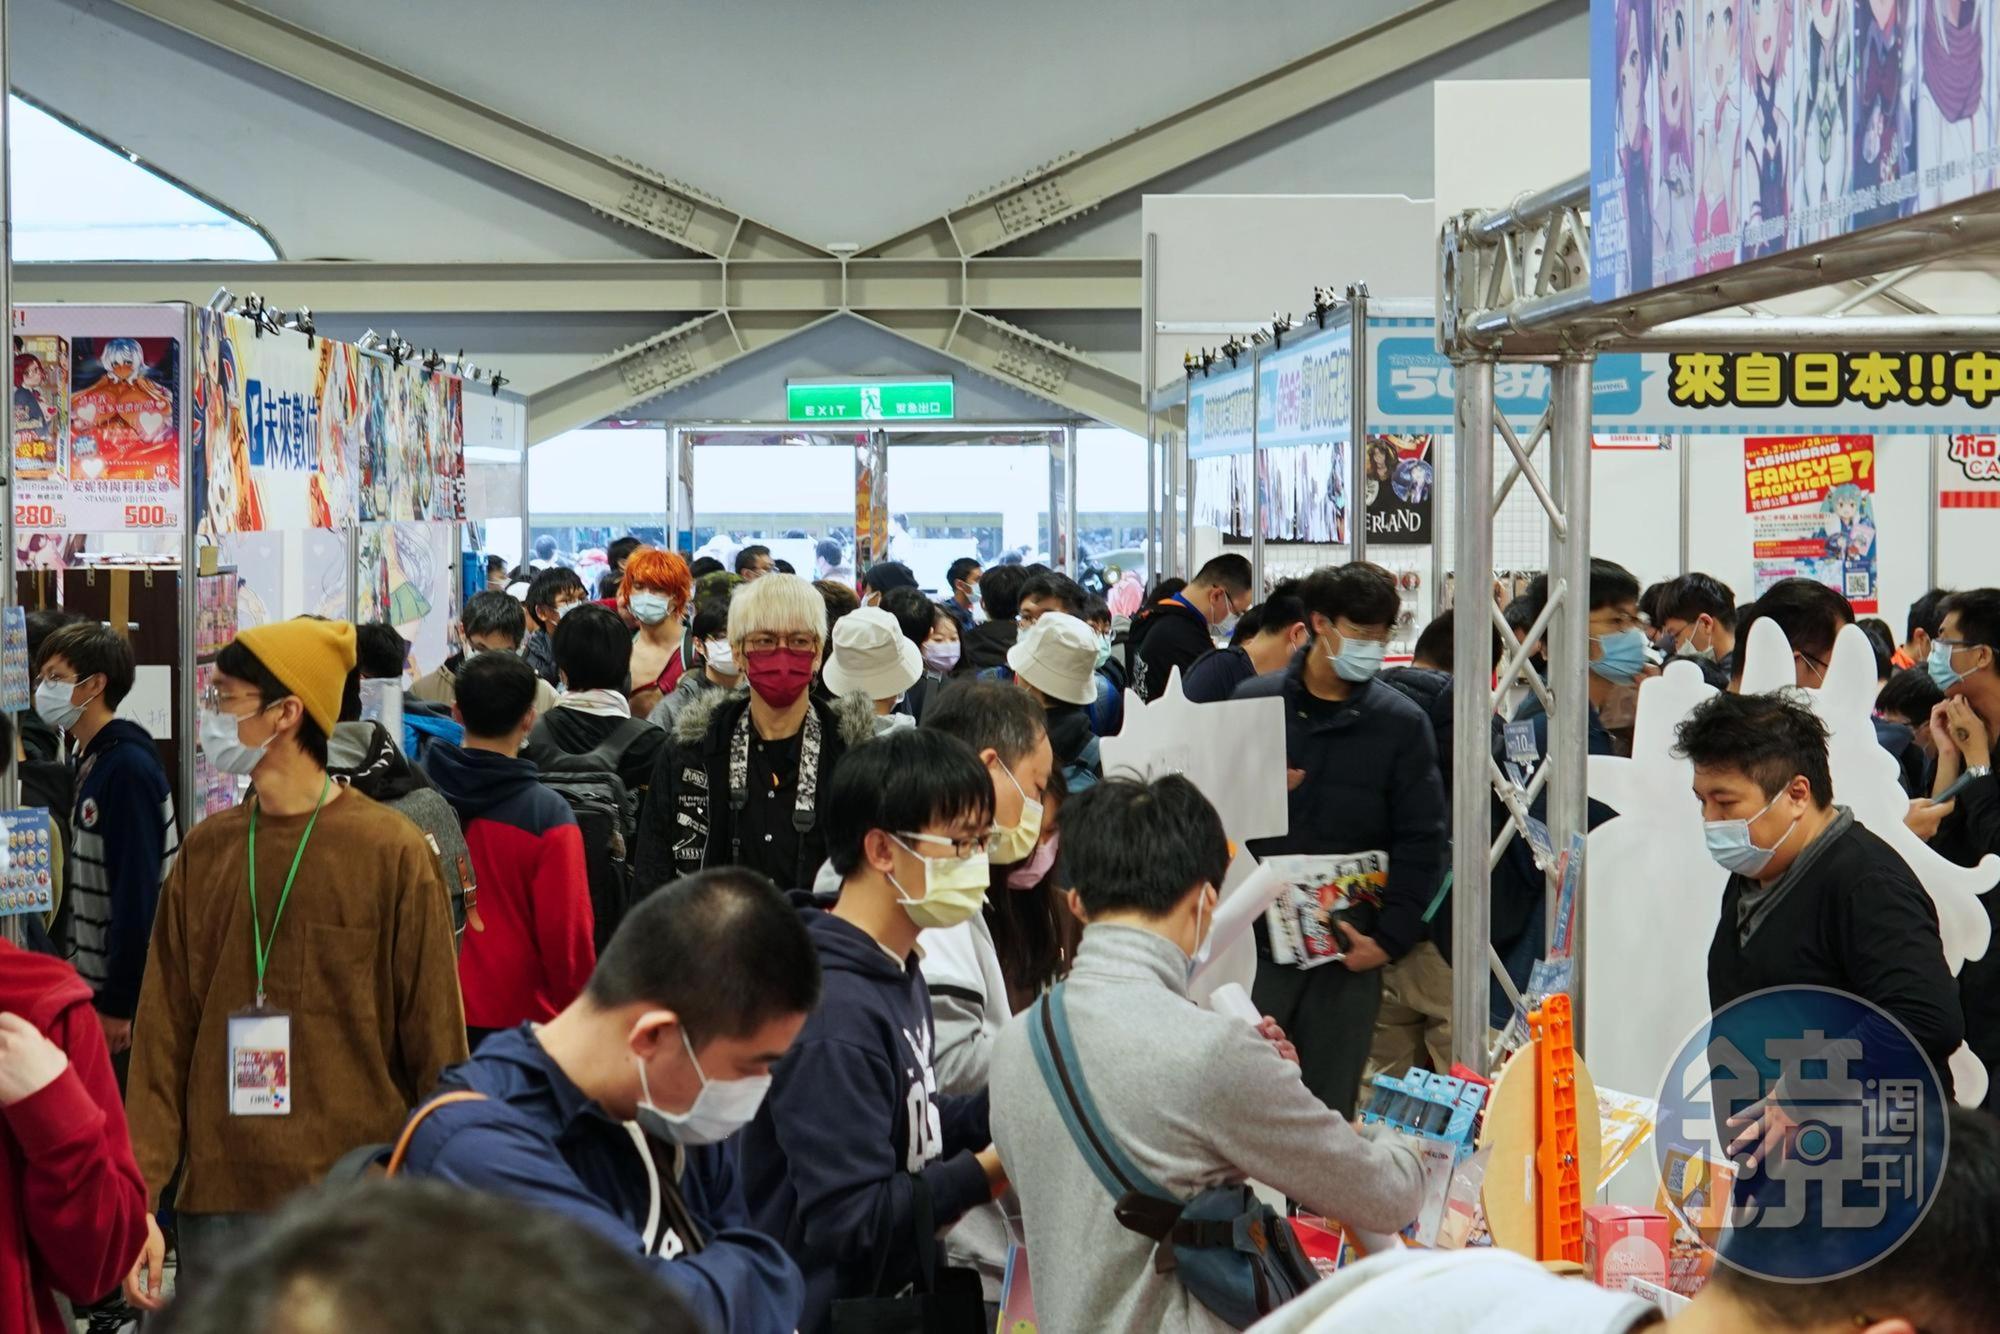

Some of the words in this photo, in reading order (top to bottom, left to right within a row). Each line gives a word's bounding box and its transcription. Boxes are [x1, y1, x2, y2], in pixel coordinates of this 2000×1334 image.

[805, 405, 847, 416] EXIT
[896, 402, 941, 415] 緊急出口
[264, 387, 319, 472] 未來數位
[1747, 457, 1828, 489] FANCY
[1828, 450, 1873, 484] 37
[1750, 475, 1831, 500] FRONTIER
